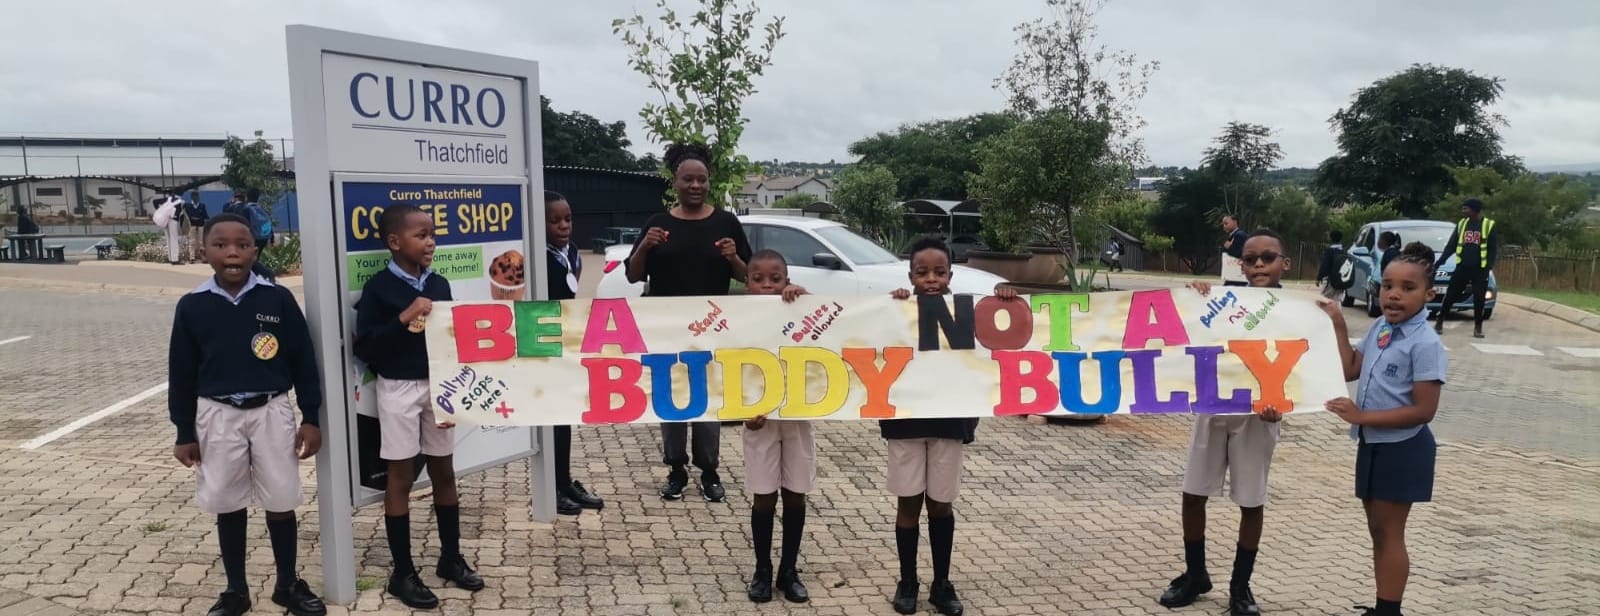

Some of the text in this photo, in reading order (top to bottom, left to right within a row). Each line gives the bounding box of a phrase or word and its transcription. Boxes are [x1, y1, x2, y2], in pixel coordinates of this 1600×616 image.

[350, 72, 506, 128] CURRO
[414, 139, 508, 164] Thatchfield
[389, 189, 482, 201] Curro Thatchfield
[457, 202, 514, 233] SHOP
[355, 258, 381, 268] Your
[455, 251, 478, 261] away
[452, 263, 479, 273] home!
[451, 288, 1191, 363] BE A NOT A
[461, 375, 493, 410] Stops
[580, 338, 1310, 424] BUDDY BULLY
